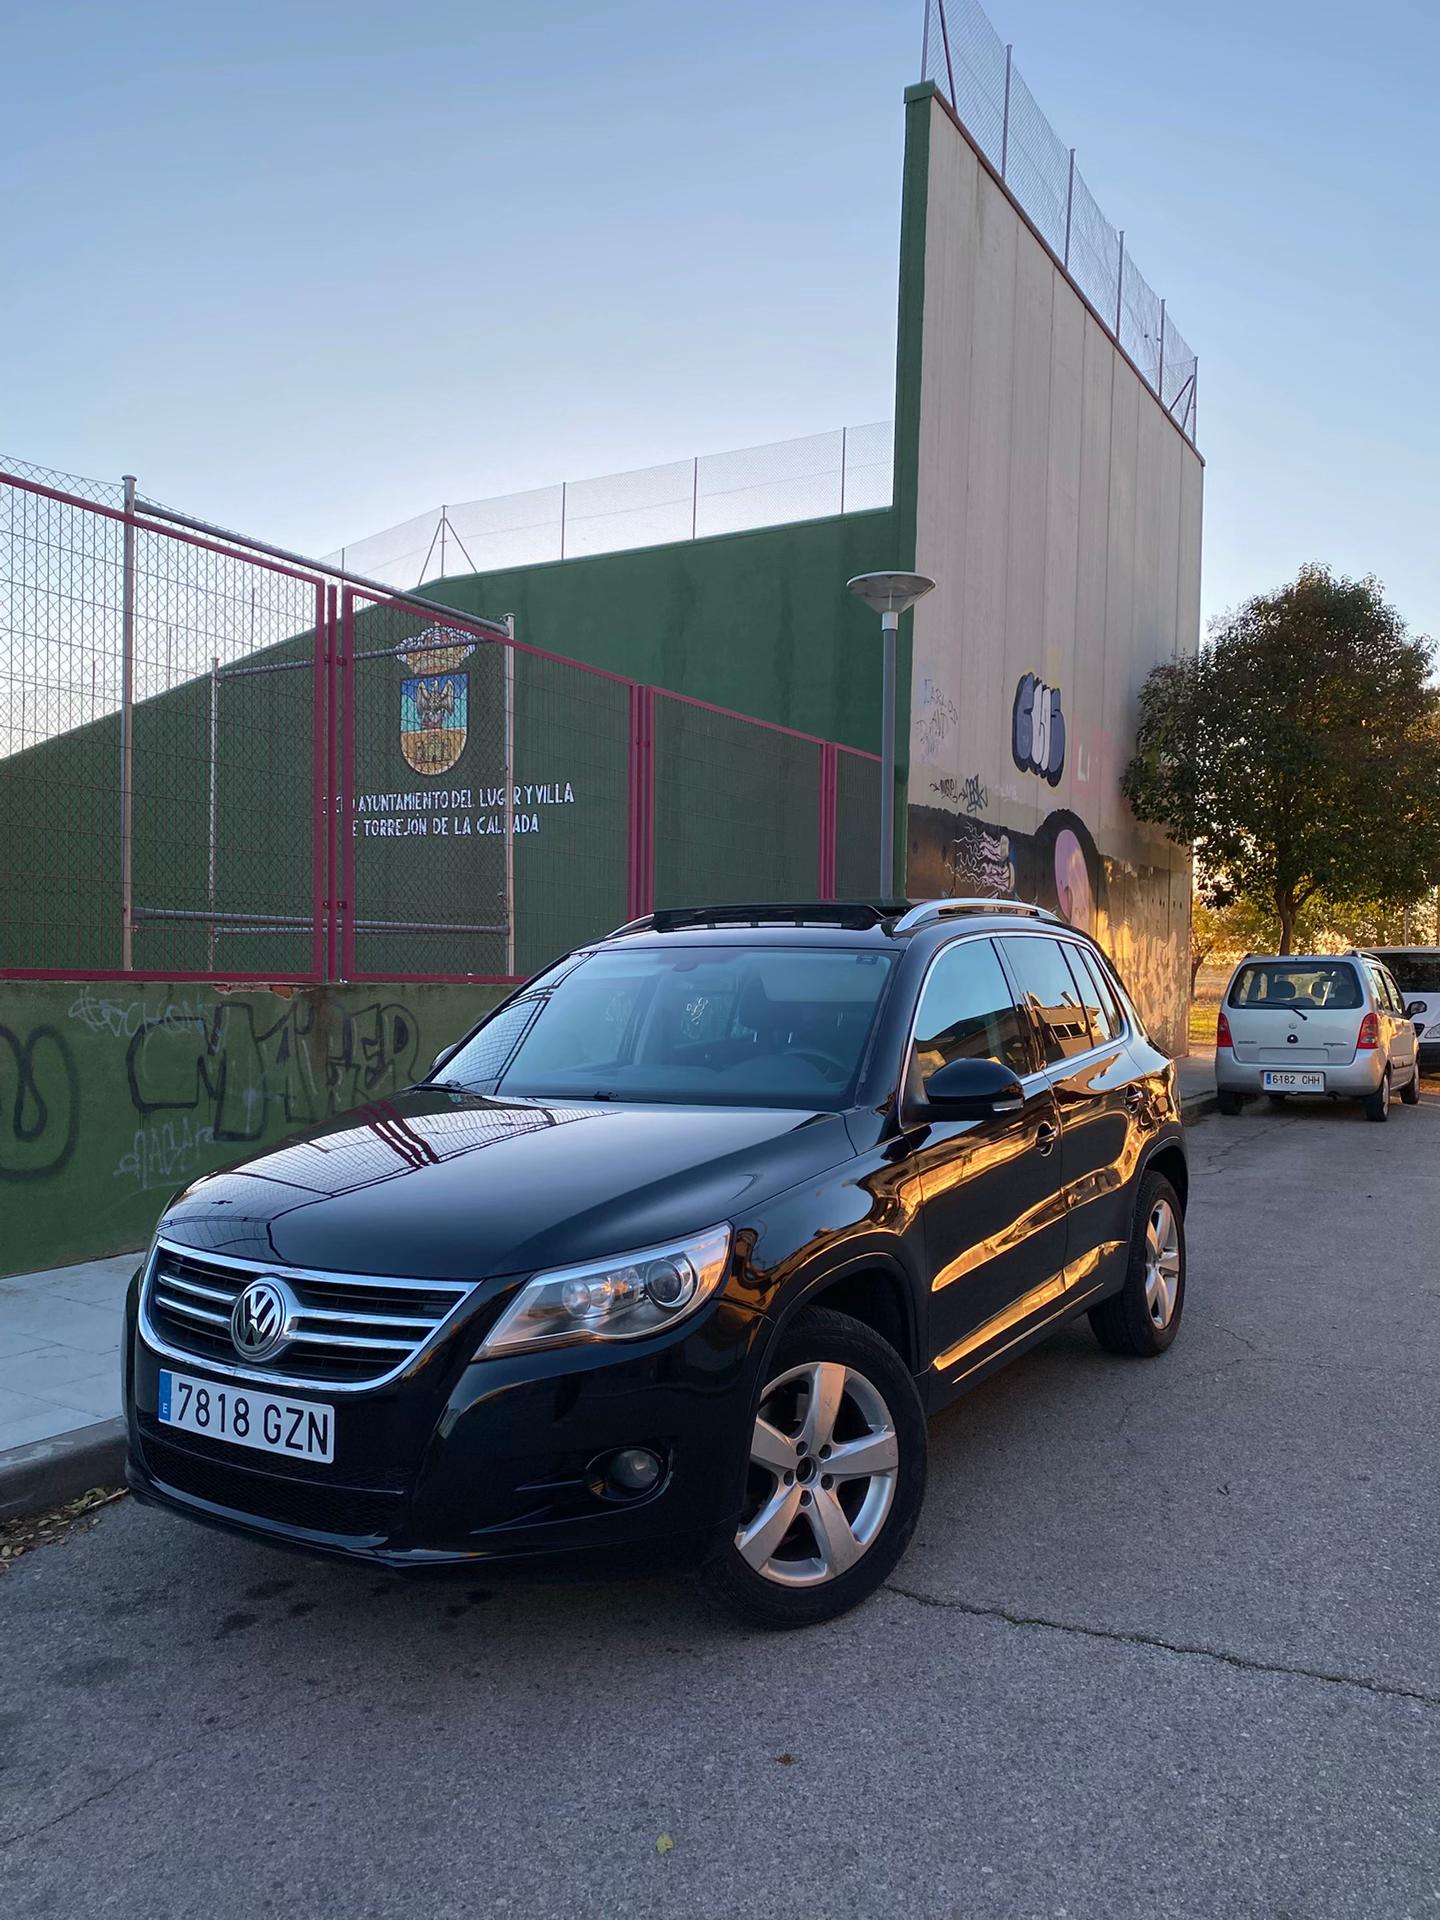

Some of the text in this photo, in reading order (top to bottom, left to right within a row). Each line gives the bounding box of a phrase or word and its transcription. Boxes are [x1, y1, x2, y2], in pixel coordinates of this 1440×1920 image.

[358, 791, 449, 812] AYUNTAMIENTO
[451, 789, 473, 809] DEL
[479, 783, 521, 807] LUGR
[523, 785, 533, 805] Y
[535, 782, 575, 804] VILLA
[432, 817, 449, 835] DE
[454, 816, 472, 835] LA
[476, 813, 539, 835] CALADA
[1272, 1075, 1296, 1085] 6182
[178, 1382, 328, 1456] 7818 GZN
